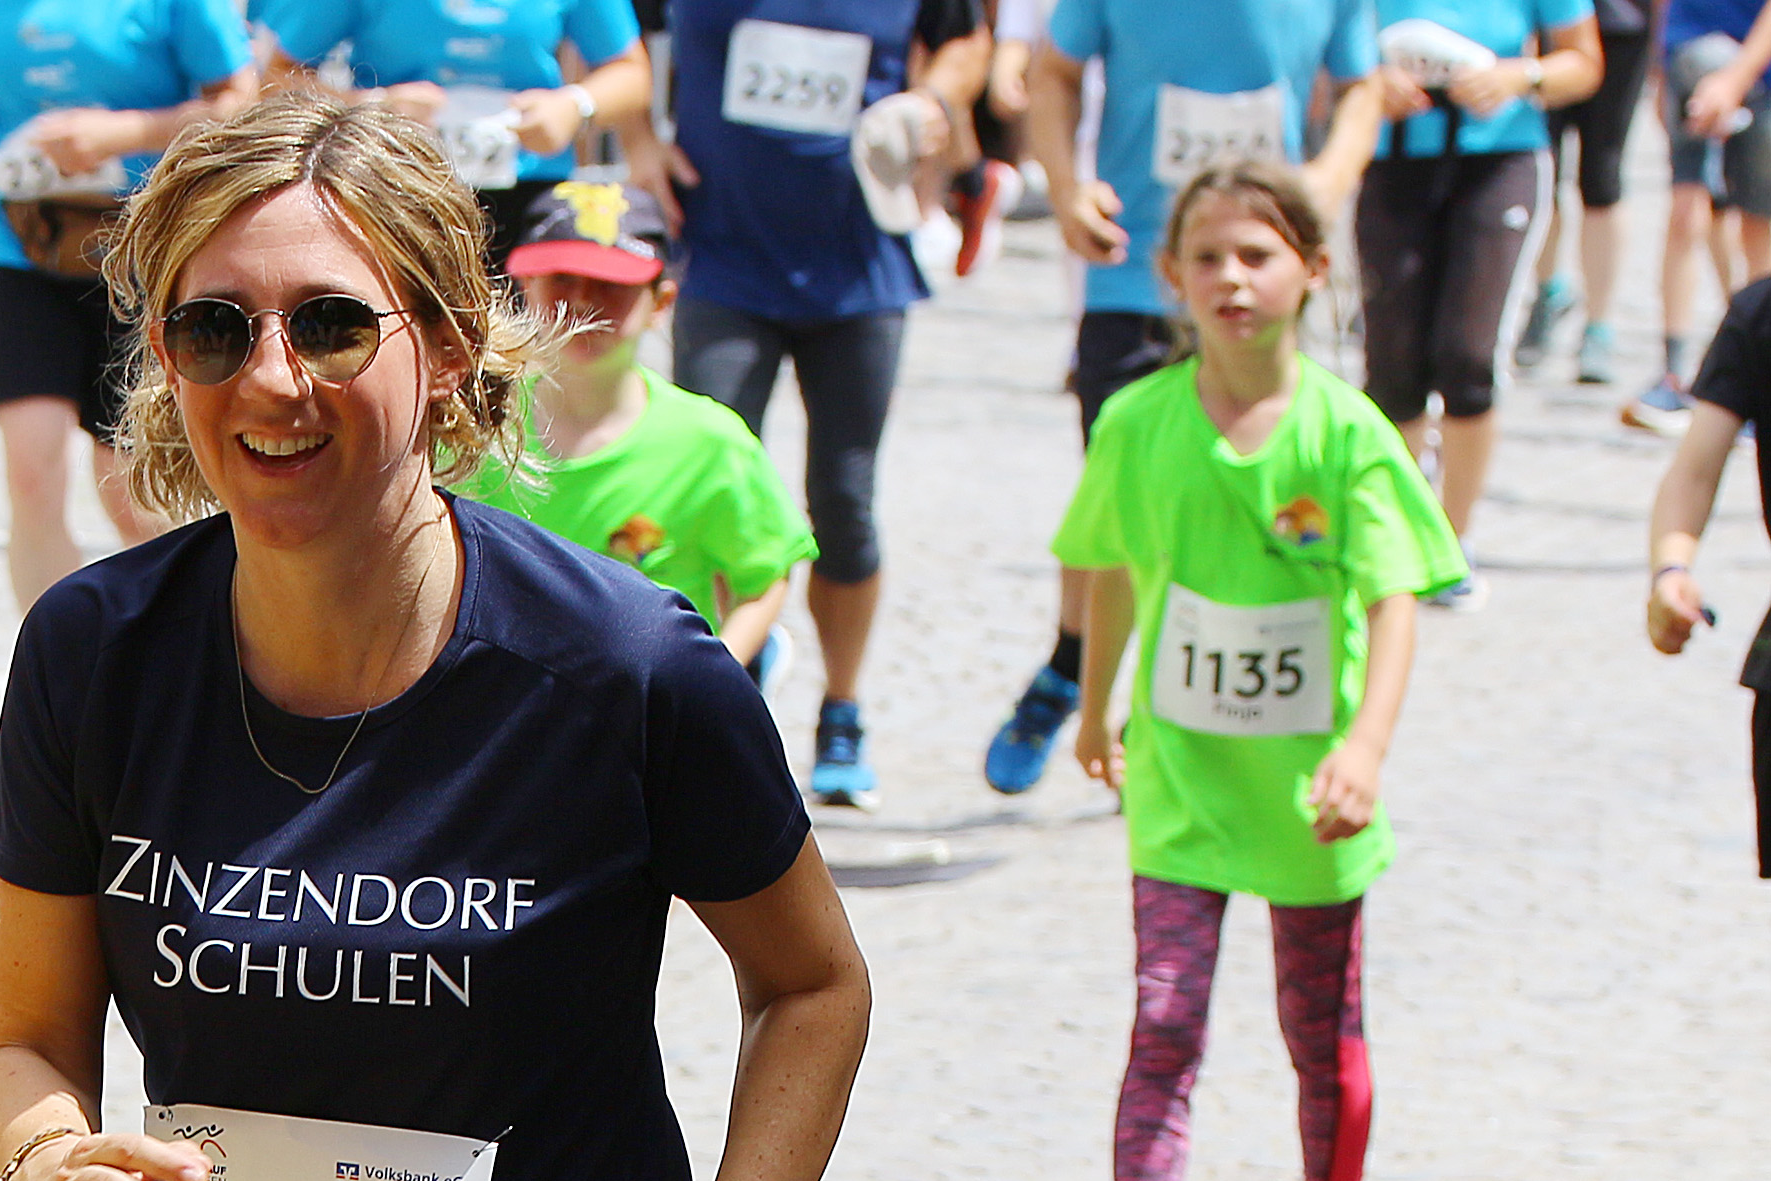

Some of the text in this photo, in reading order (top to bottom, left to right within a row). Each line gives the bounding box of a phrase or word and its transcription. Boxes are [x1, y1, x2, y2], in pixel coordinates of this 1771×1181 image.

[741, 62, 849, 109] 2259
[1181, 642, 1304, 698] 1135
[105, 835, 536, 931] ZINZENDORF
[153, 924, 471, 1007] SCHULEN
